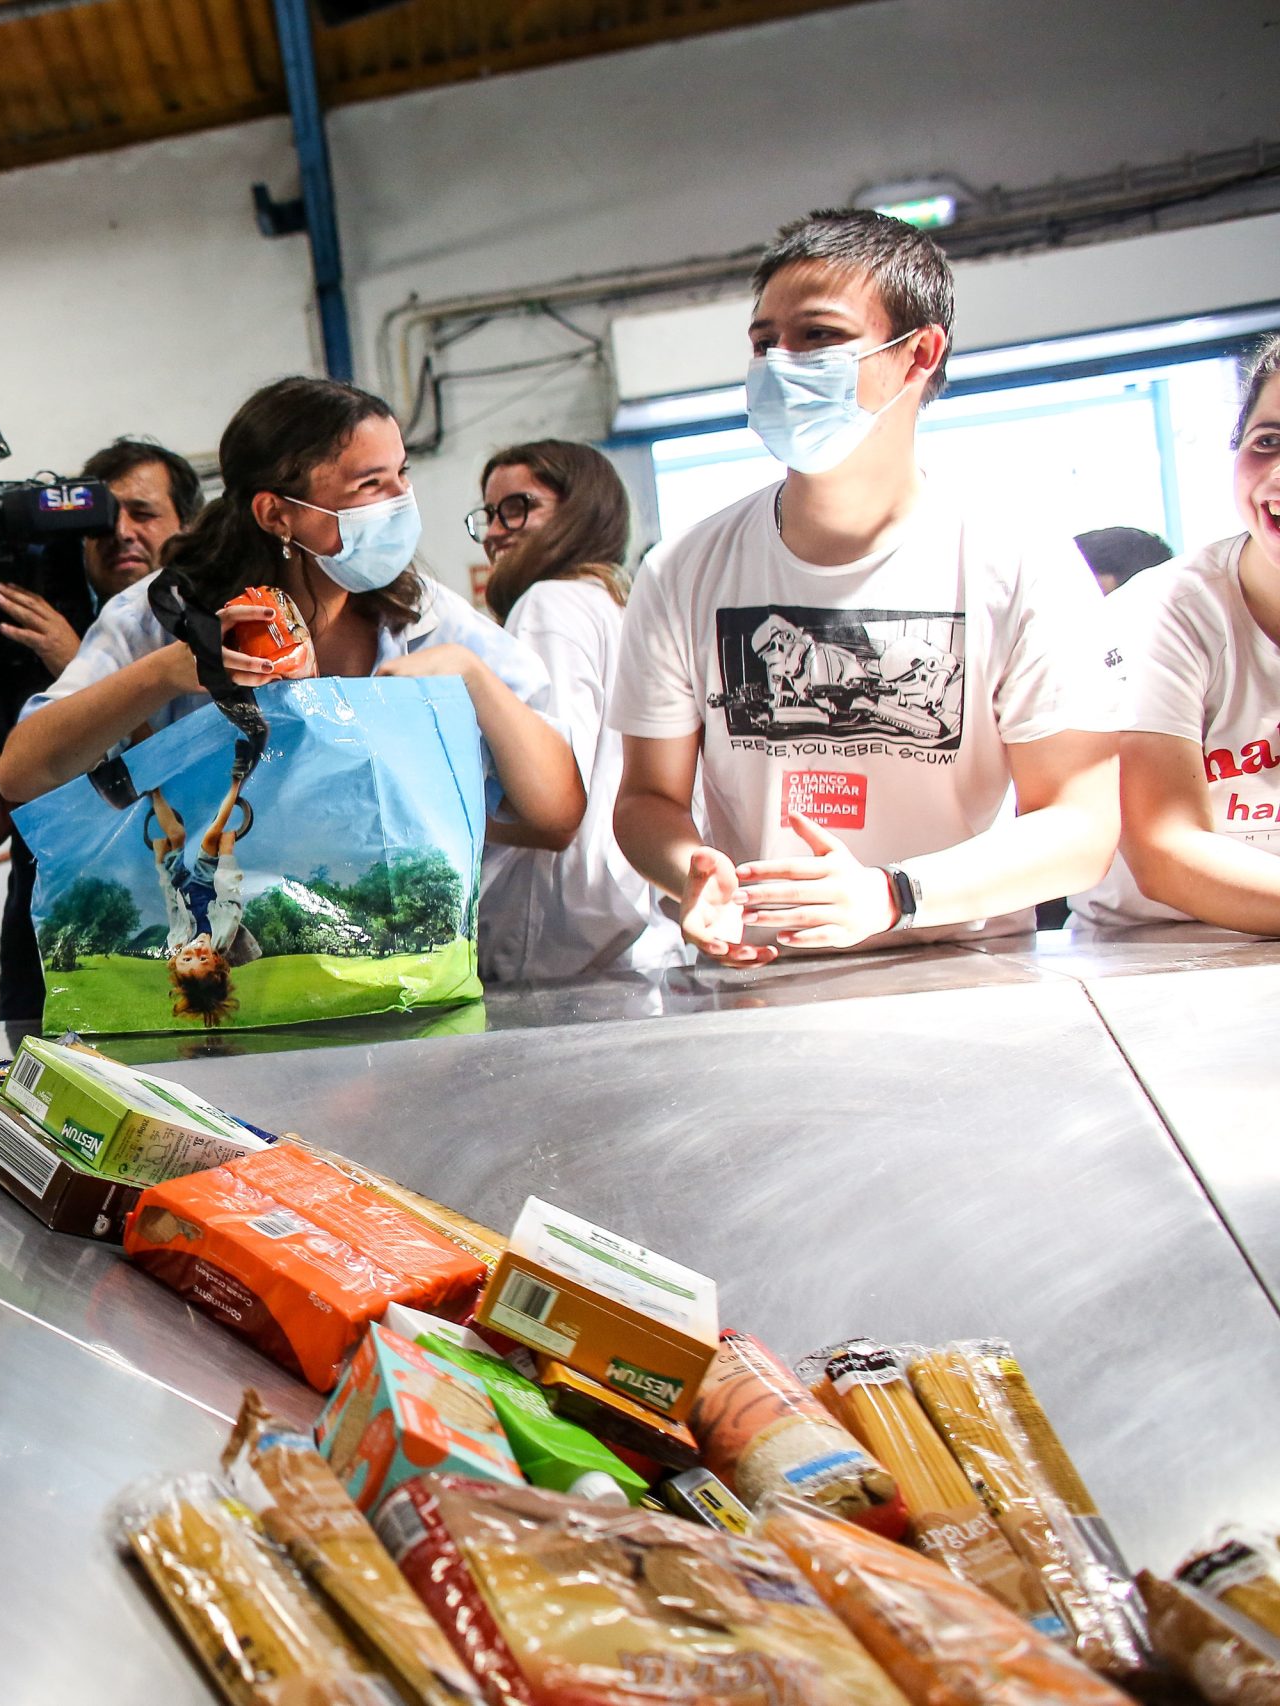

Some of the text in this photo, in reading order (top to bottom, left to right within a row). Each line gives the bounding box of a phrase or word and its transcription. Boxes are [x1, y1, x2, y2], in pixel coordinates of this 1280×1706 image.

[792, 743, 827, 756] YOU
[832, 743, 893, 758] REBEL
[789, 774, 847, 785] O BANCO
[789, 784, 859, 796] ALIMENTAR
[789, 794, 814, 803] TEM
[788, 803, 858, 815] FIDELIDADE
[61, 1123, 103, 1154] NESTUM
[604, 1362, 684, 1404] NESTUM
